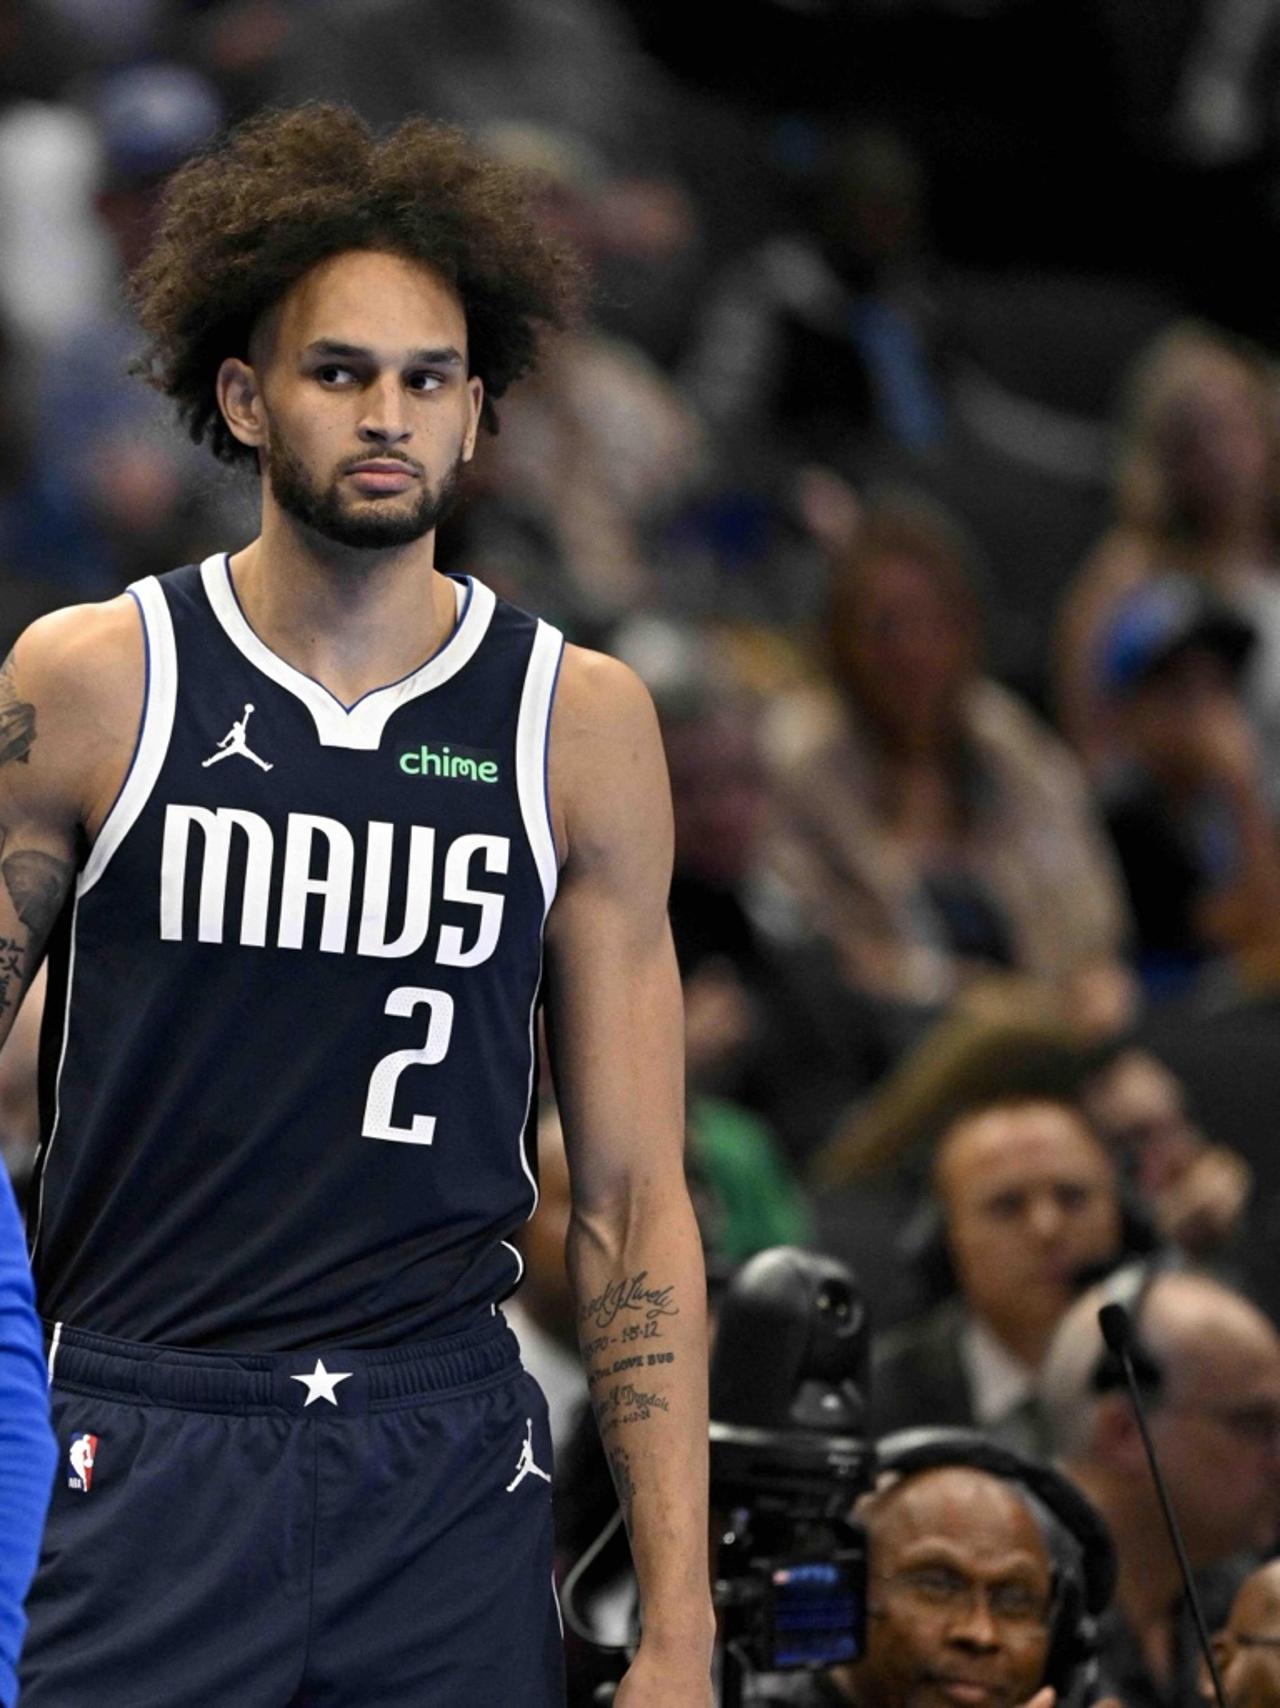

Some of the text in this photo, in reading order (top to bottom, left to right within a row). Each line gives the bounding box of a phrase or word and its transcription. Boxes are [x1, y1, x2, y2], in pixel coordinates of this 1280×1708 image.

[399, 745, 499, 783] chime
[160, 803, 510, 968] MAVS
[361, 986, 455, 1146] 2
